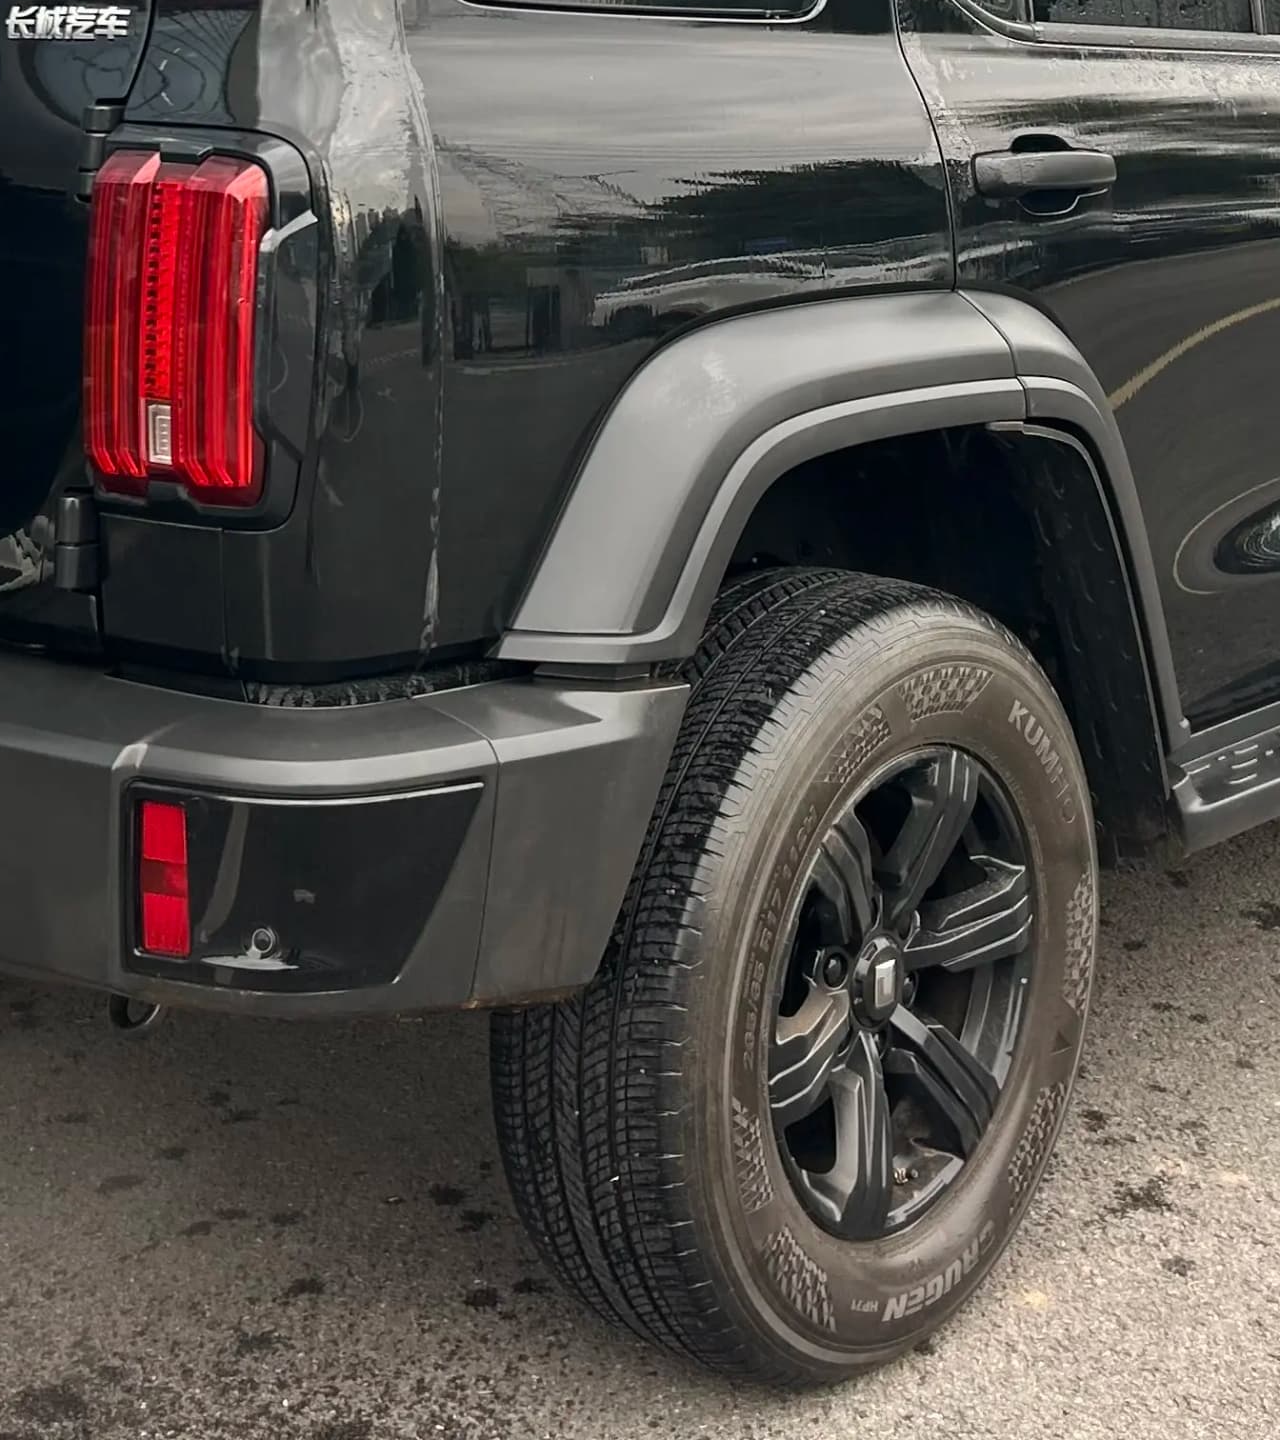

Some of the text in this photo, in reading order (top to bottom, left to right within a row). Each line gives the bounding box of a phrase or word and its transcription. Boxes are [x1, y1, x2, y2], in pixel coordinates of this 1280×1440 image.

[5, 6, 131, 40] 长城汽车
[1008, 699, 1076, 824] KUMHO
[881, 1219, 996, 1323] CRUGEN
